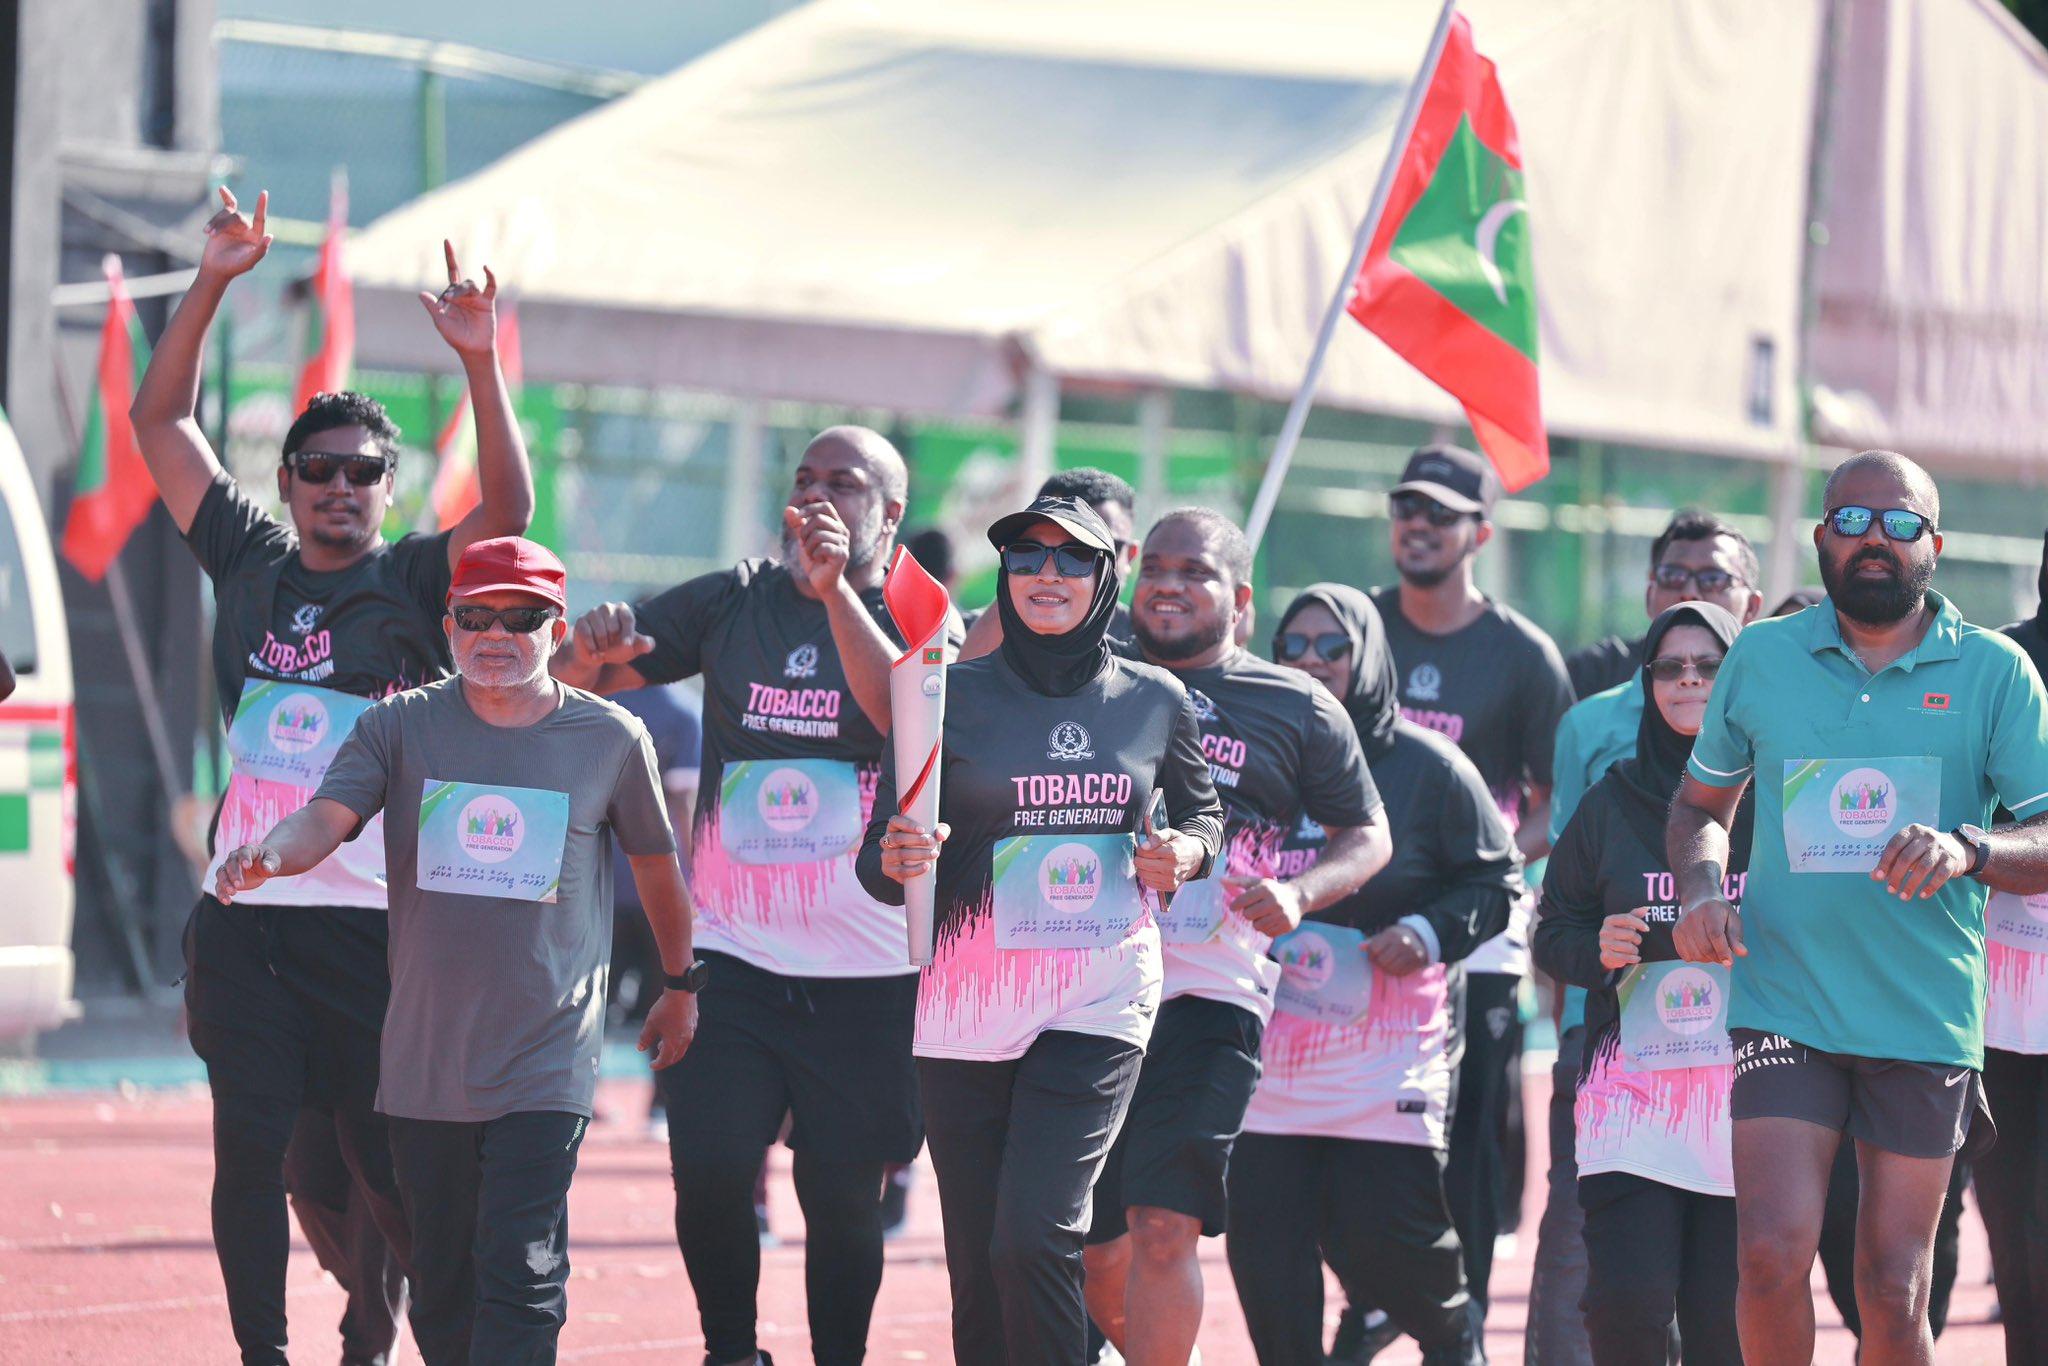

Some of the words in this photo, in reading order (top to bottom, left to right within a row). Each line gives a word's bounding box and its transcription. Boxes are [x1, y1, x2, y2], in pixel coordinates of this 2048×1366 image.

[749, 682, 841, 718] TOBACCO
[742, 713, 770, 730] FREE
[769, 717, 839, 738] GENERATION
[1011, 772, 1132, 806] TOBACCO
[1014, 809, 1045, 827] FREE
[1049, 808, 1125, 826] GENERATION
[1840, 809, 1888, 820] TOBACCO
[465, 834, 515, 847] TOBACCO
[1049, 886, 1095, 895] TOBACCO
[1760, 1034, 1793, 1052] AIR
